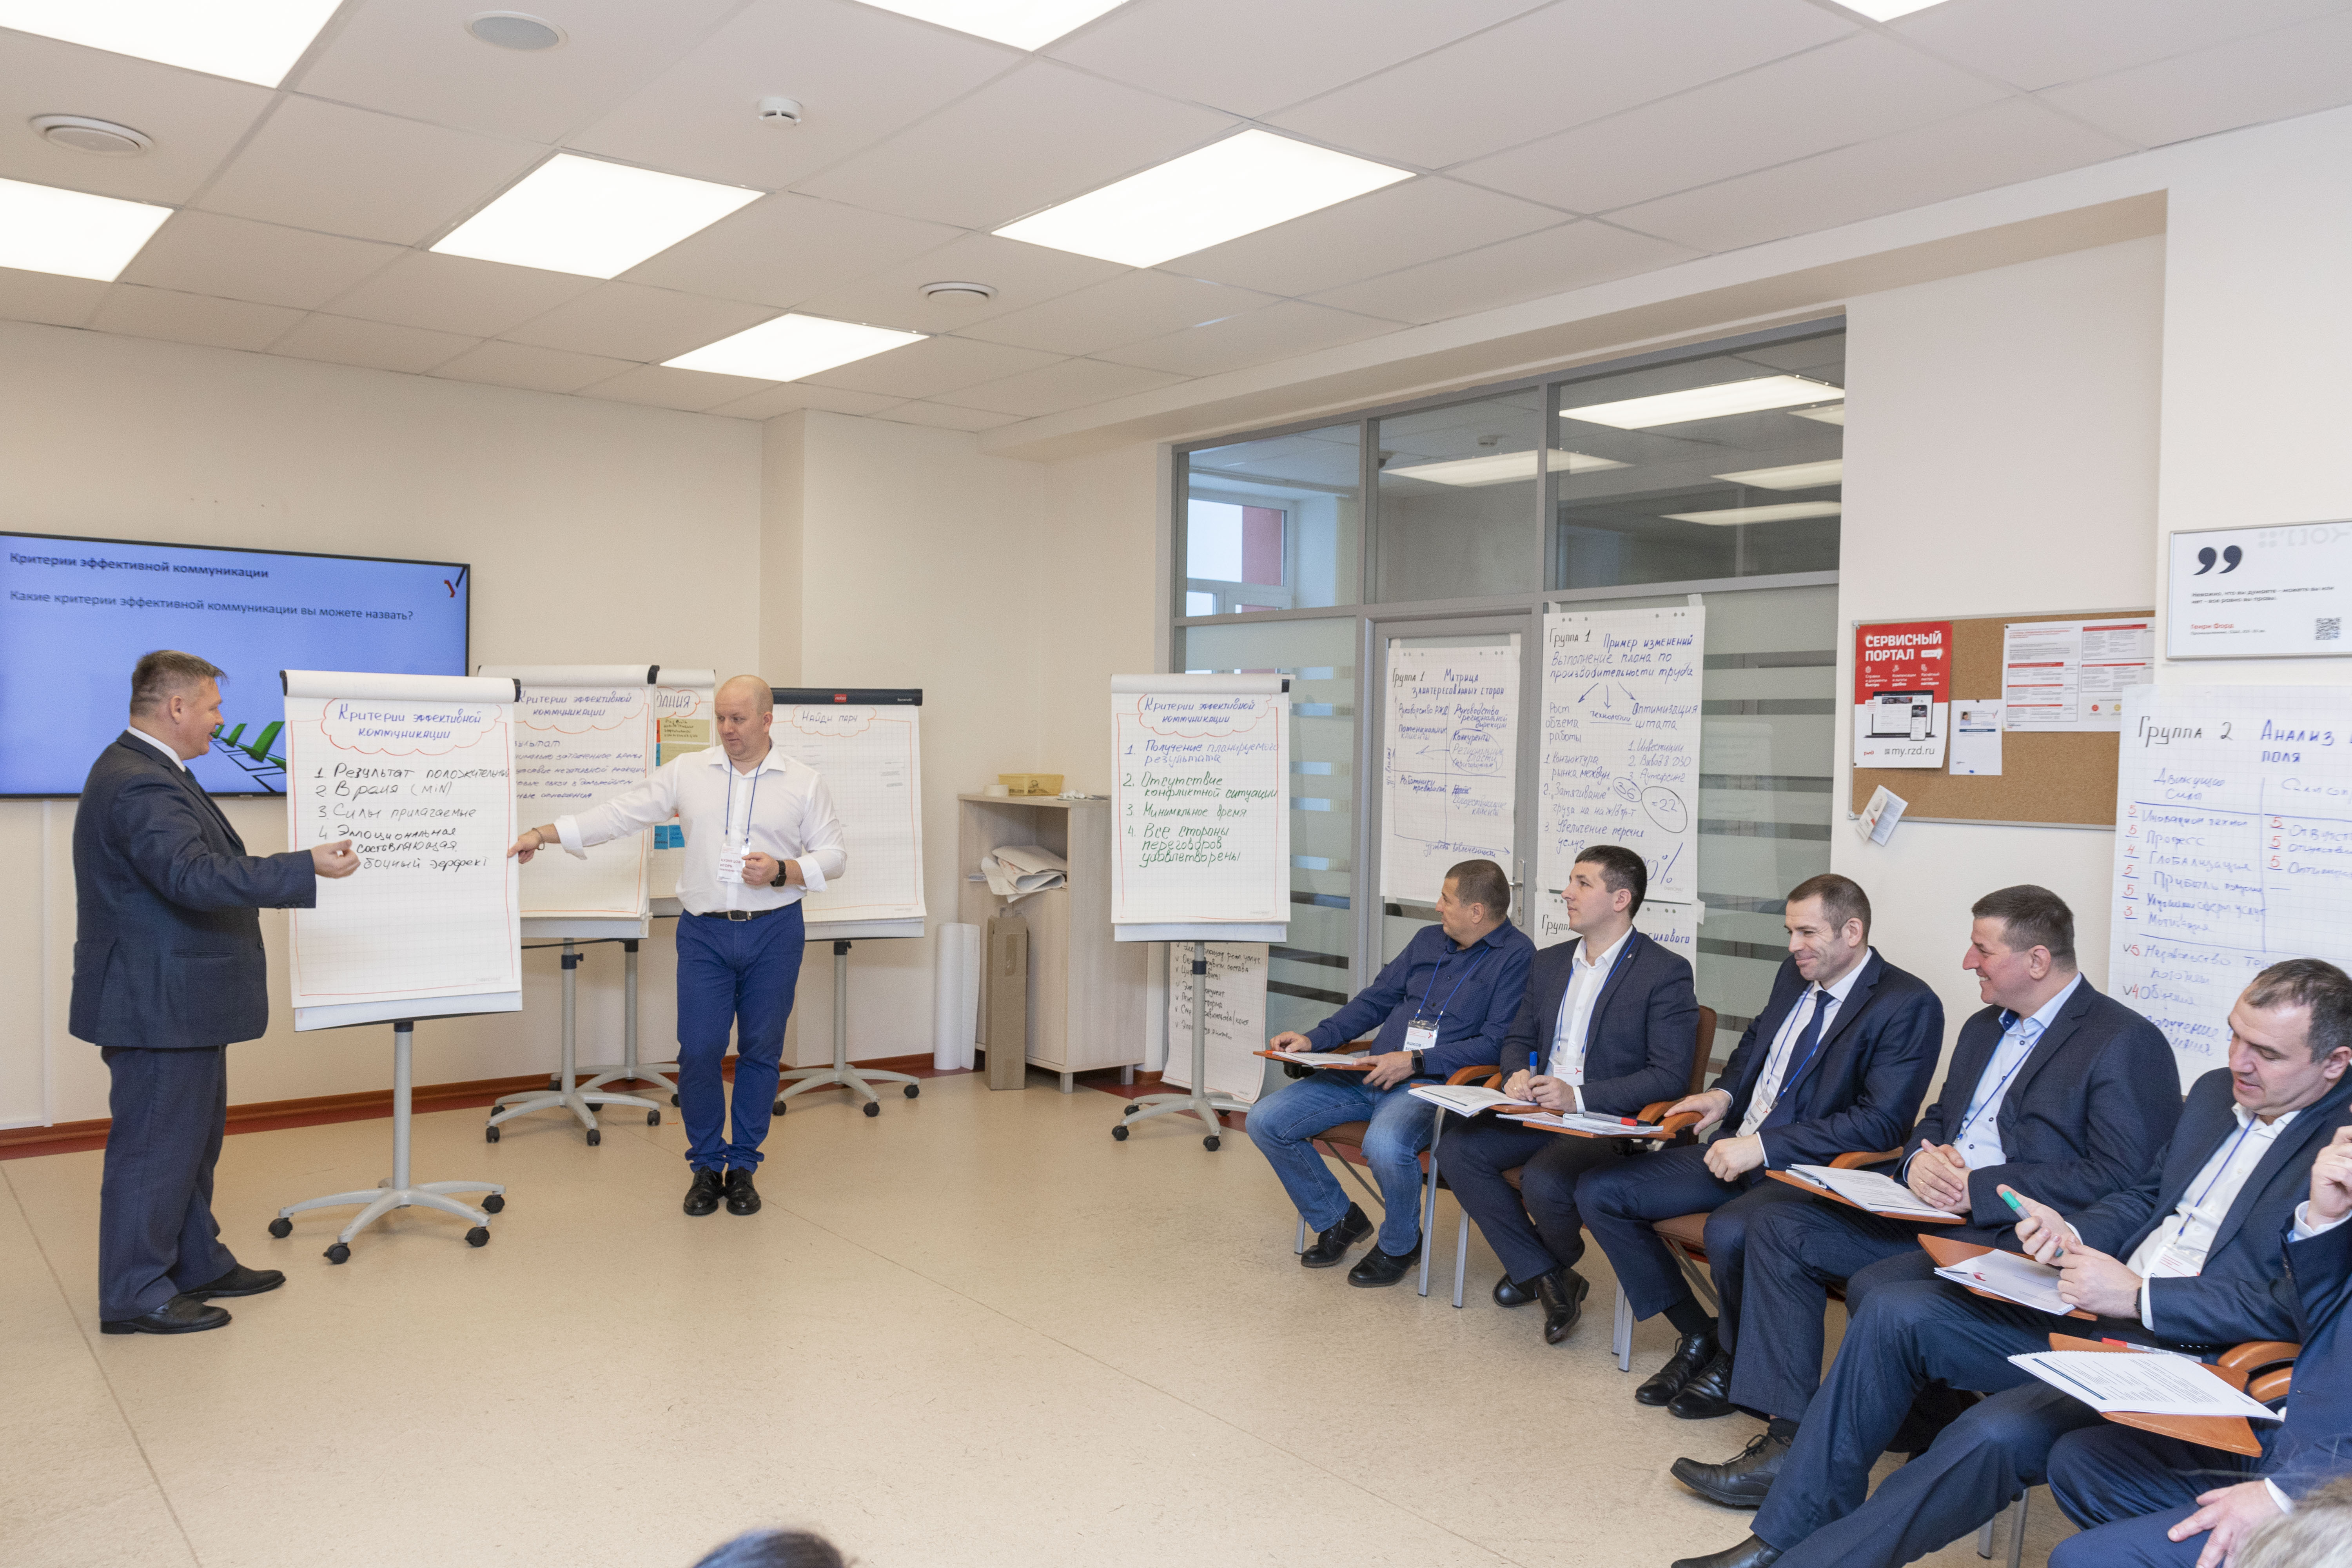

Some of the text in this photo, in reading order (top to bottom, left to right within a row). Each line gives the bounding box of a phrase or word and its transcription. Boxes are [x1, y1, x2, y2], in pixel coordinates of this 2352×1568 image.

[10, 553, 269, 578] Критерии эффективной коммуникации
[10, 590, 414, 620] Какие критерии эффективной коммуникации вы можете назвать?
[1549, 628, 1591, 648] Группа 1
[1603, 633, 1693, 653] Пример изменений
[1865, 630, 1942, 648] СЕРВИСНЫЙ
[1551, 651, 1672, 666] Выполнение плана по
[1865, 648, 1915, 662] ПОРТАЛ
[1392, 668, 1479, 688] Группа 1 Матрица
[1550, 661, 1693, 684] производительности труда
[573, 691, 632, 703] эффективной
[1481, 686, 1504, 699] сторон
[1144, 697, 1255, 712] Критерии эффективной
[1550, 702, 1570, 714] Рост
[1632, 702, 1698, 716] Оптимизация
[338, 703, 481, 724] Критерии эффективной
[533, 709, 606, 717] коммуникации
[802, 711, 858, 724] Найди пару
[1161, 715, 1230, 724] коммуникации
[1545, 716, 1579, 729] объема
[1635, 720, 1677, 731] штата
[358, 727, 451, 740] коммуникации
[1452, 730, 1490, 746] Конкуренты
[1549, 730, 1582, 745] работы
[2138, 716, 2335, 748] Группа 2 Анализ
[1124, 739, 1279, 757] 1. Получение планируемого
[1637, 738, 1684, 753] Инвестиции
[1891, 745, 1935, 757] my.rzd.ru
[1144, 754, 1221, 768] результата
[2261, 750, 2301, 763] поля
[334, 762, 416, 779] Результат
[1552, 768, 1577, 780] рынка
[1123, 771, 1223, 788] 2. Отсутствие
[1144, 786, 1278, 802] конфликтной ситуации
[1615, 782, 1636, 799] 36
[333, 802, 382, 819] Силы
[390, 808, 476, 822] прилагаемые
[1143, 801, 1208, 818] Минимальное
[1216, 804, 1247, 821] время
[1553, 803, 1575, 818] груза
[2127, 805, 2136, 815] 5
[2128, 824, 2137, 835] 5
[2269, 817, 2283, 828] 5
[1143, 822, 1171, 838] Все
[1178, 826, 1229, 842] стороны
[1556, 819, 1644, 842] Увеличение перечня
[1142, 836, 1223, 856] переговоров
[1556, 837, 1585, 855] услуг
[2270, 835, 2282, 847] 5
[363, 857, 421, 870] бочный
[1139, 849, 1241, 868] удовлетворены
[2270, 855, 2282, 868] 5
[2124, 864, 2135, 875] 5
[2124, 884, 2135, 896] 5
[2123, 906, 2133, 916] 3
[1541, 914, 1573, 936] Групп
